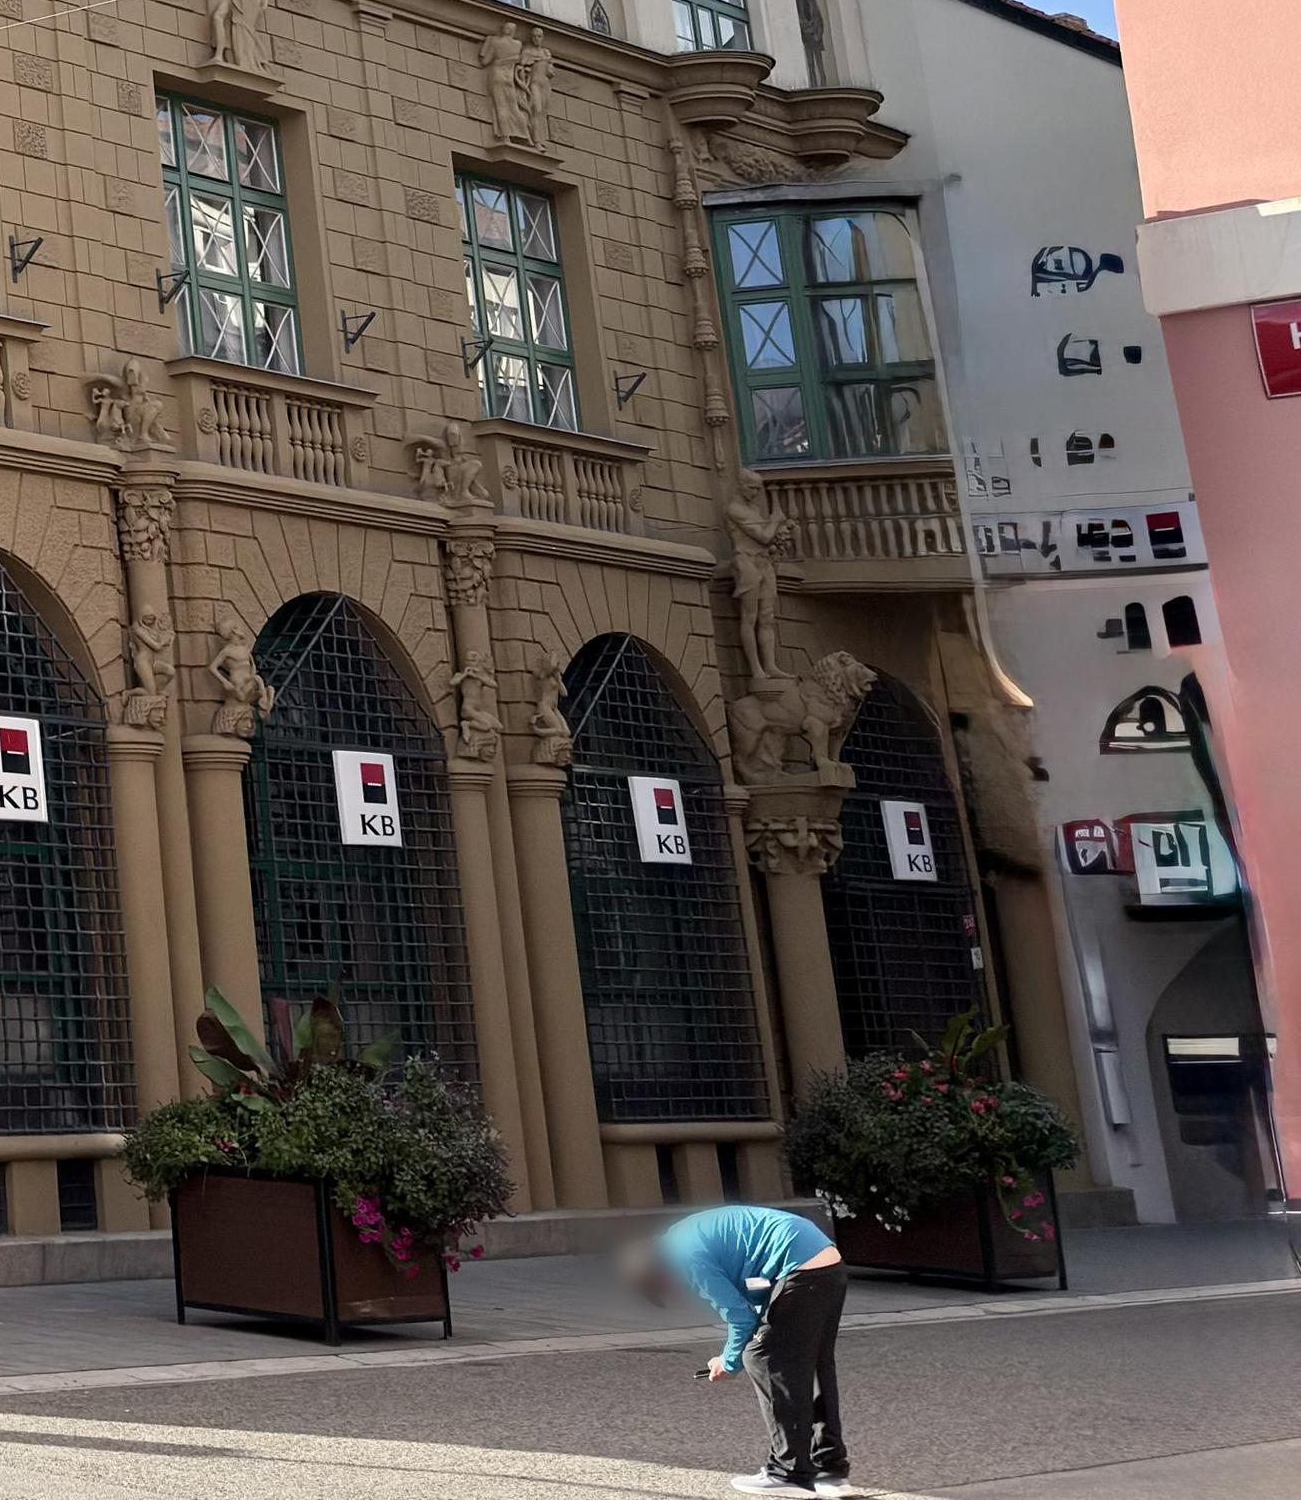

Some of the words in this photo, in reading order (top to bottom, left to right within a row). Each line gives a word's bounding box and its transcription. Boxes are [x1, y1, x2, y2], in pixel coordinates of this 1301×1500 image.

[360, 814, 395, 836] KB
[656, 834, 686, 855] KB
[907, 853, 933, 873] KB
